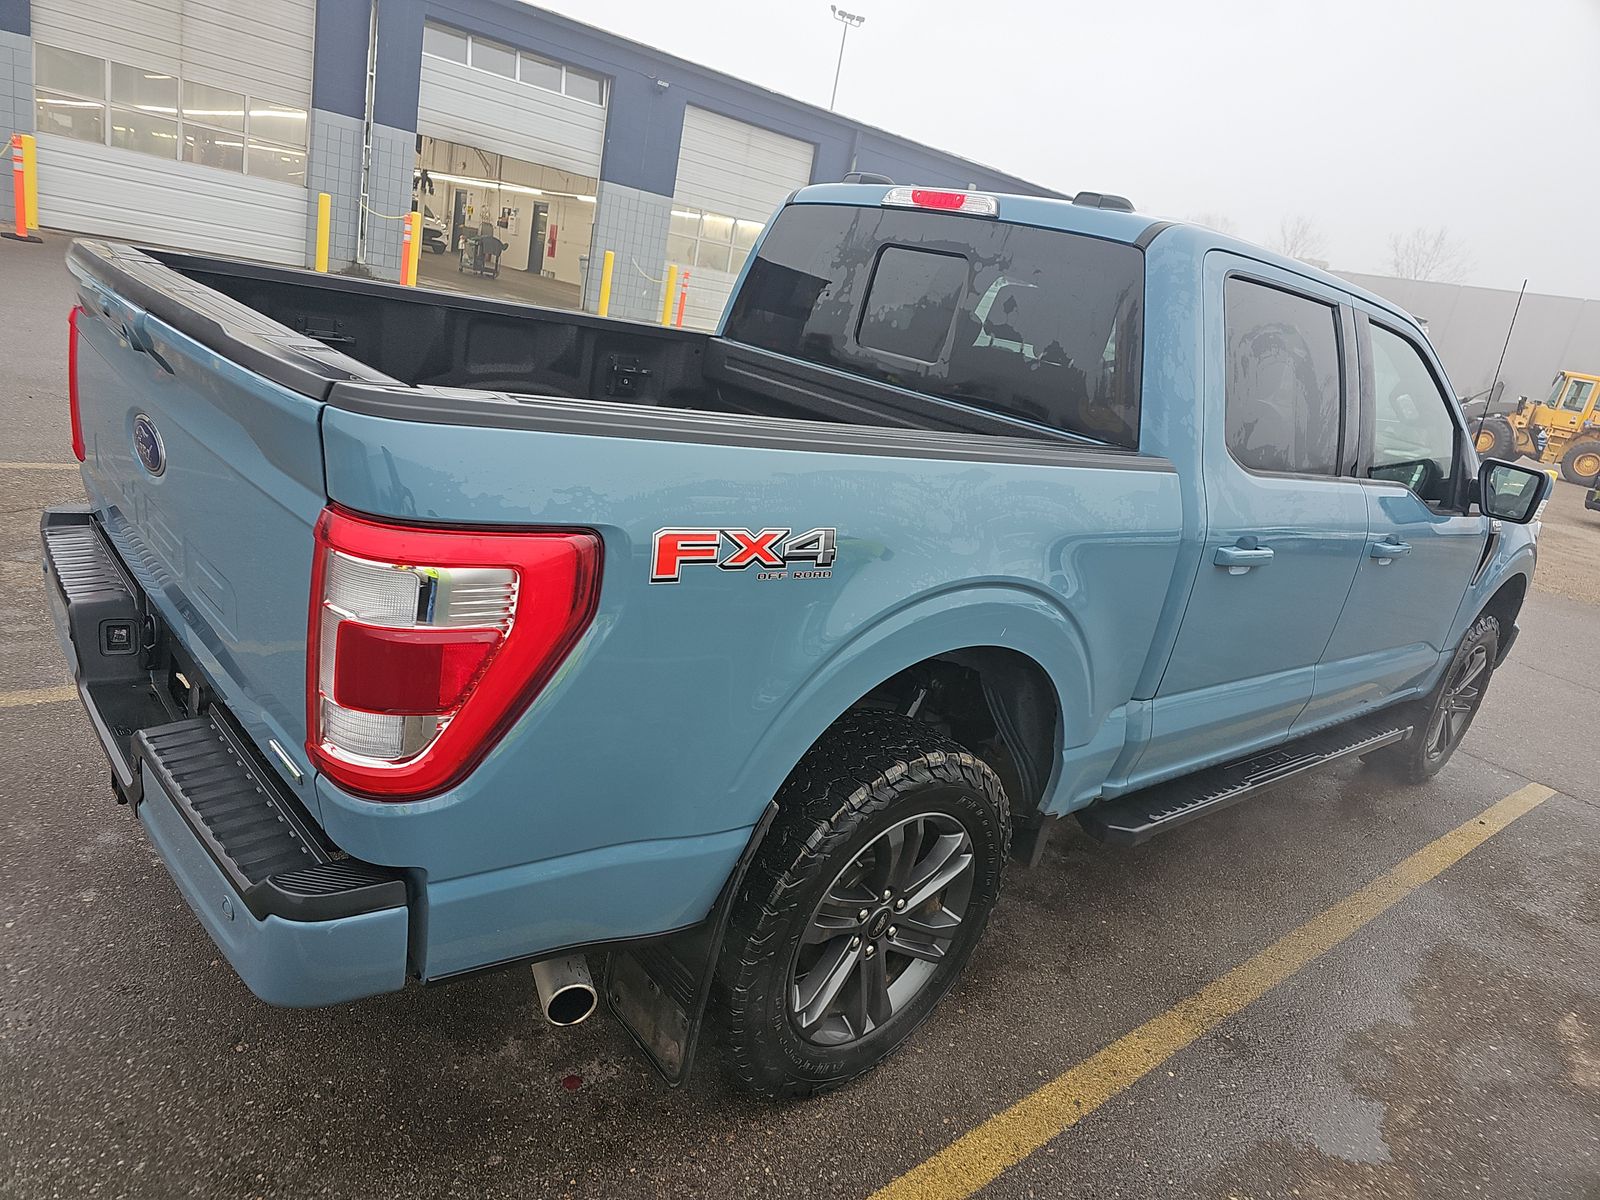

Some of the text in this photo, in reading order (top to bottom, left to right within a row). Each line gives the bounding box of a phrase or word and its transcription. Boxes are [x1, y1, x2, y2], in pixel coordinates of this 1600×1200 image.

[650, 527, 837, 584] FX4
[757, 570, 832, 581] OFF ROAD
